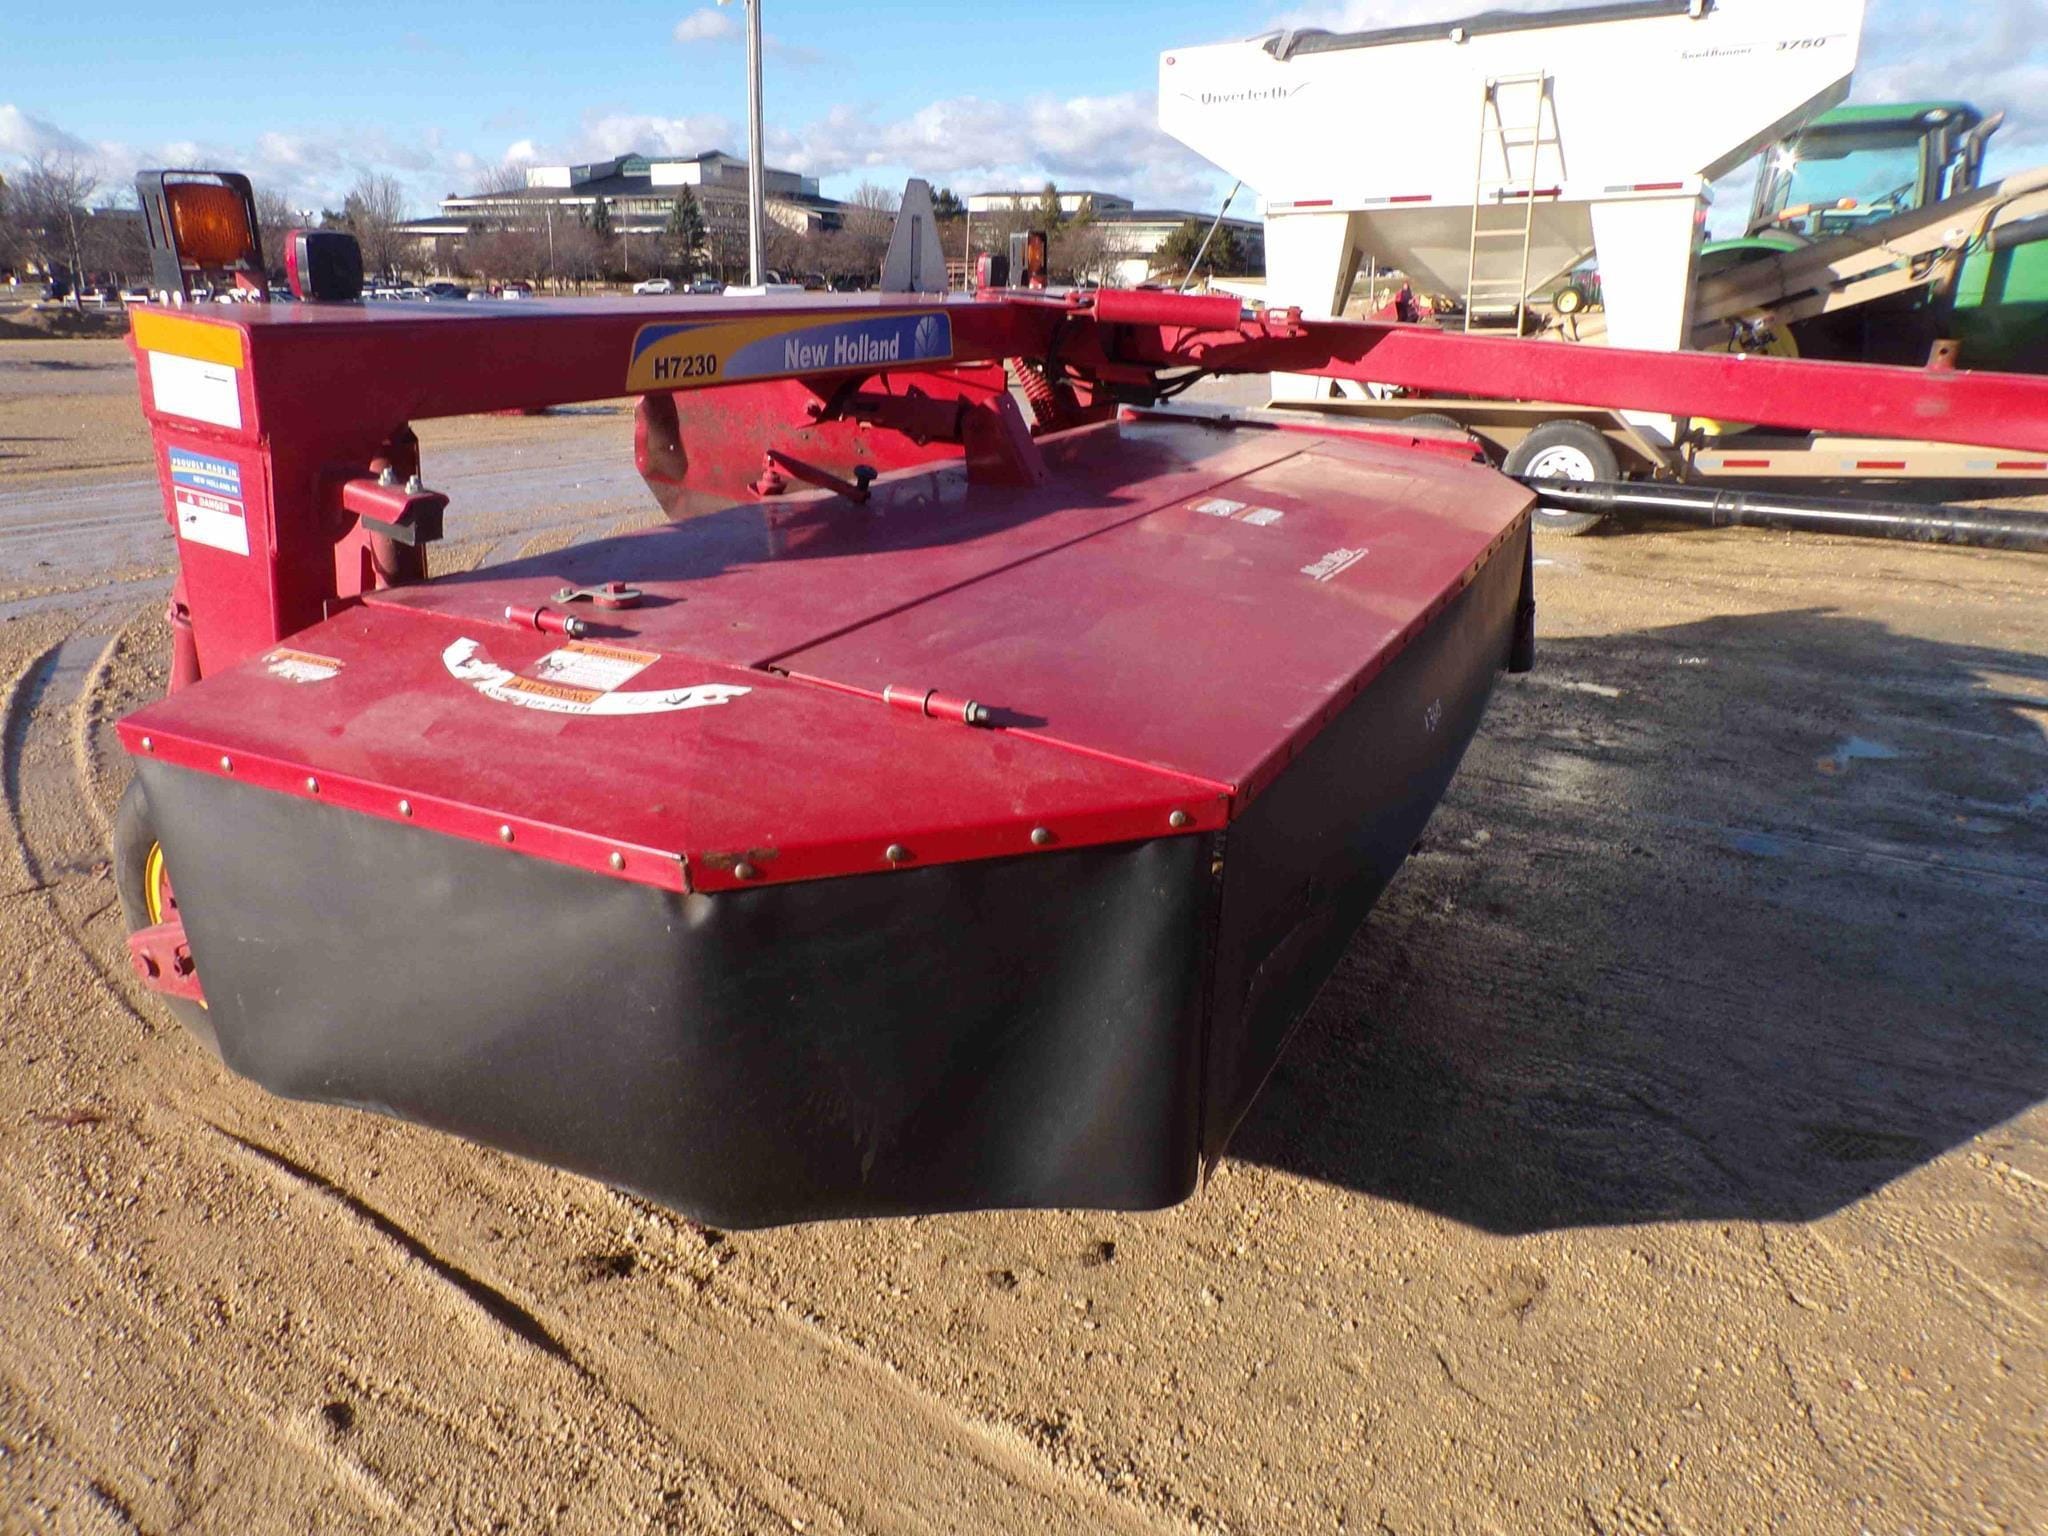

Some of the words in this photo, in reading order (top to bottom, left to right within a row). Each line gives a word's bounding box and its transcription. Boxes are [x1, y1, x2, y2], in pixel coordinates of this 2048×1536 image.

[1776, 37, 1826, 52] 3750
[784, 338, 828, 370] New
[833, 331, 900, 365] Holland
[654, 354, 718, 380] H7230
[172, 457, 204, 470] PROUDLY
[206, 463, 226, 475] MADE
[198, 496, 230, 512] DANGER
[525, 681, 592, 704] WARNING
